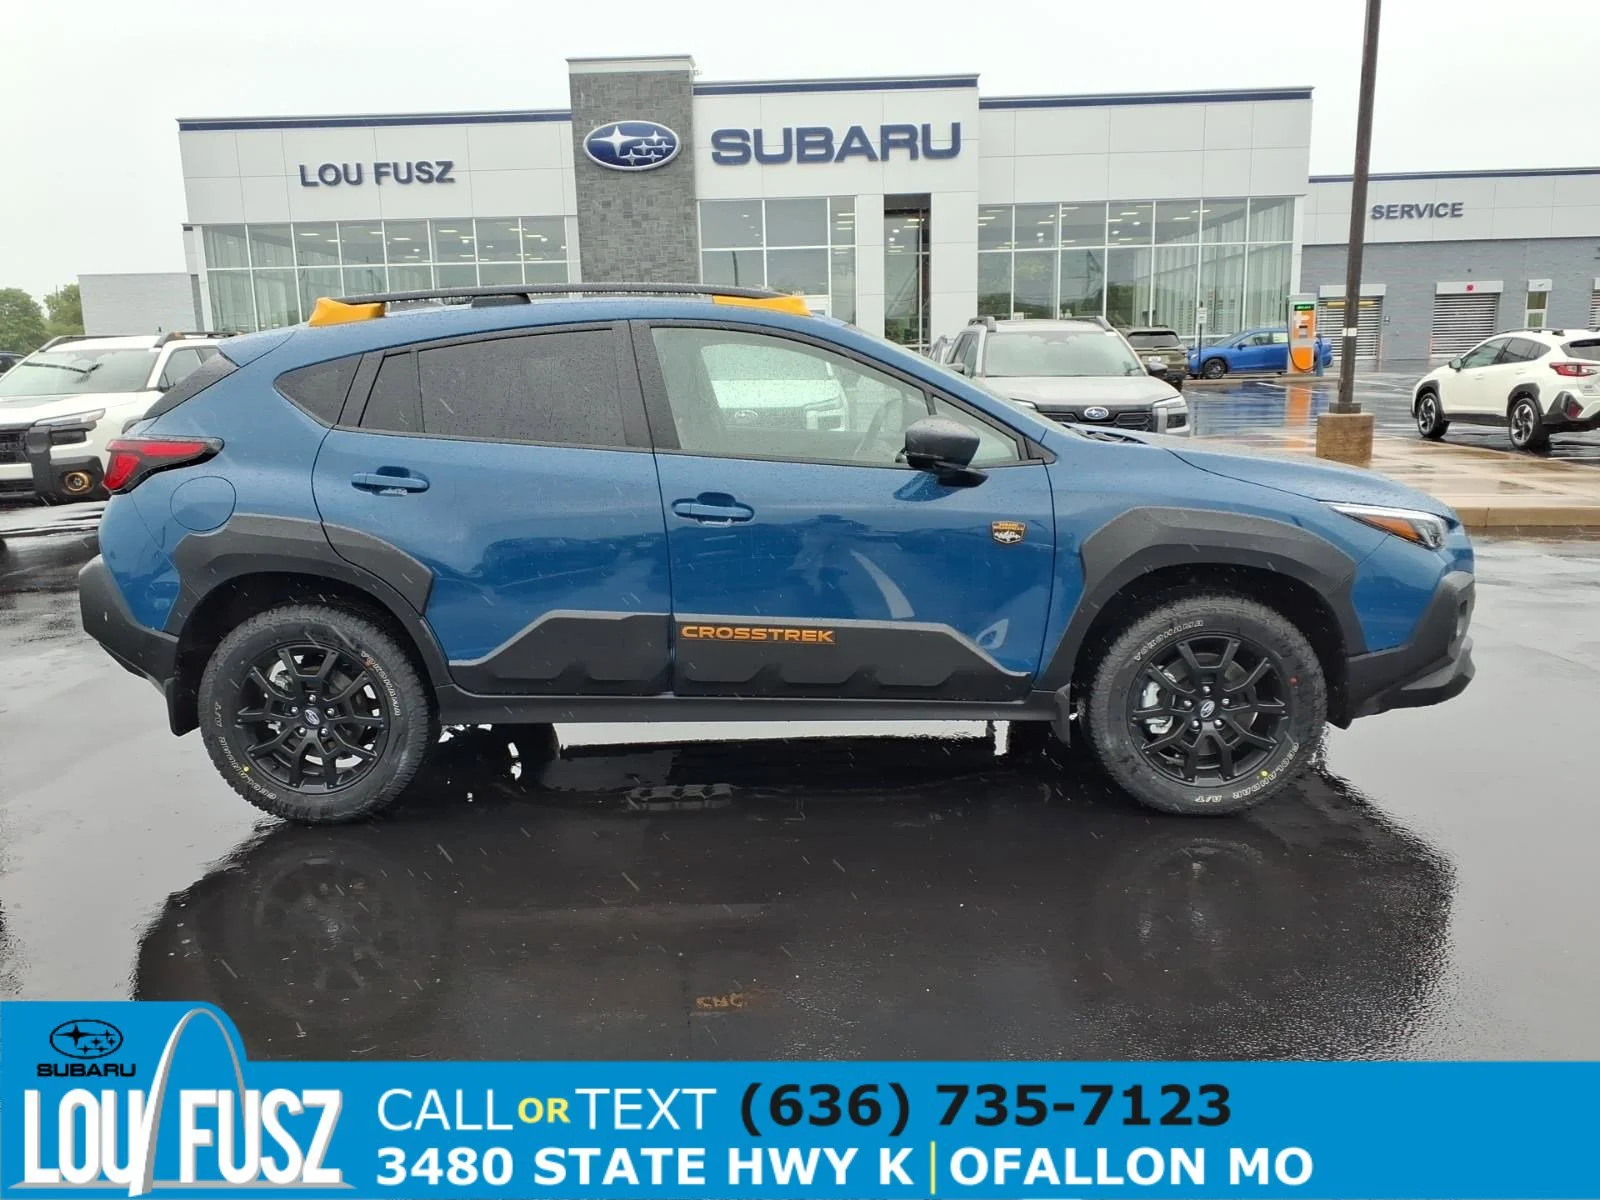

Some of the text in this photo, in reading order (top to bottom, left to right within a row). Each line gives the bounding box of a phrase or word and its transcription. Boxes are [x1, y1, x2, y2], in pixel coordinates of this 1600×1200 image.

[711, 122, 961, 165] SUBARU
[299, 160, 456, 188] LOU FUSZ
[1371, 202, 1464, 220] SERVICE
[681, 625, 834, 643] CROSSTREK
[1134, 620, 1204, 661] YOKOHAMA
